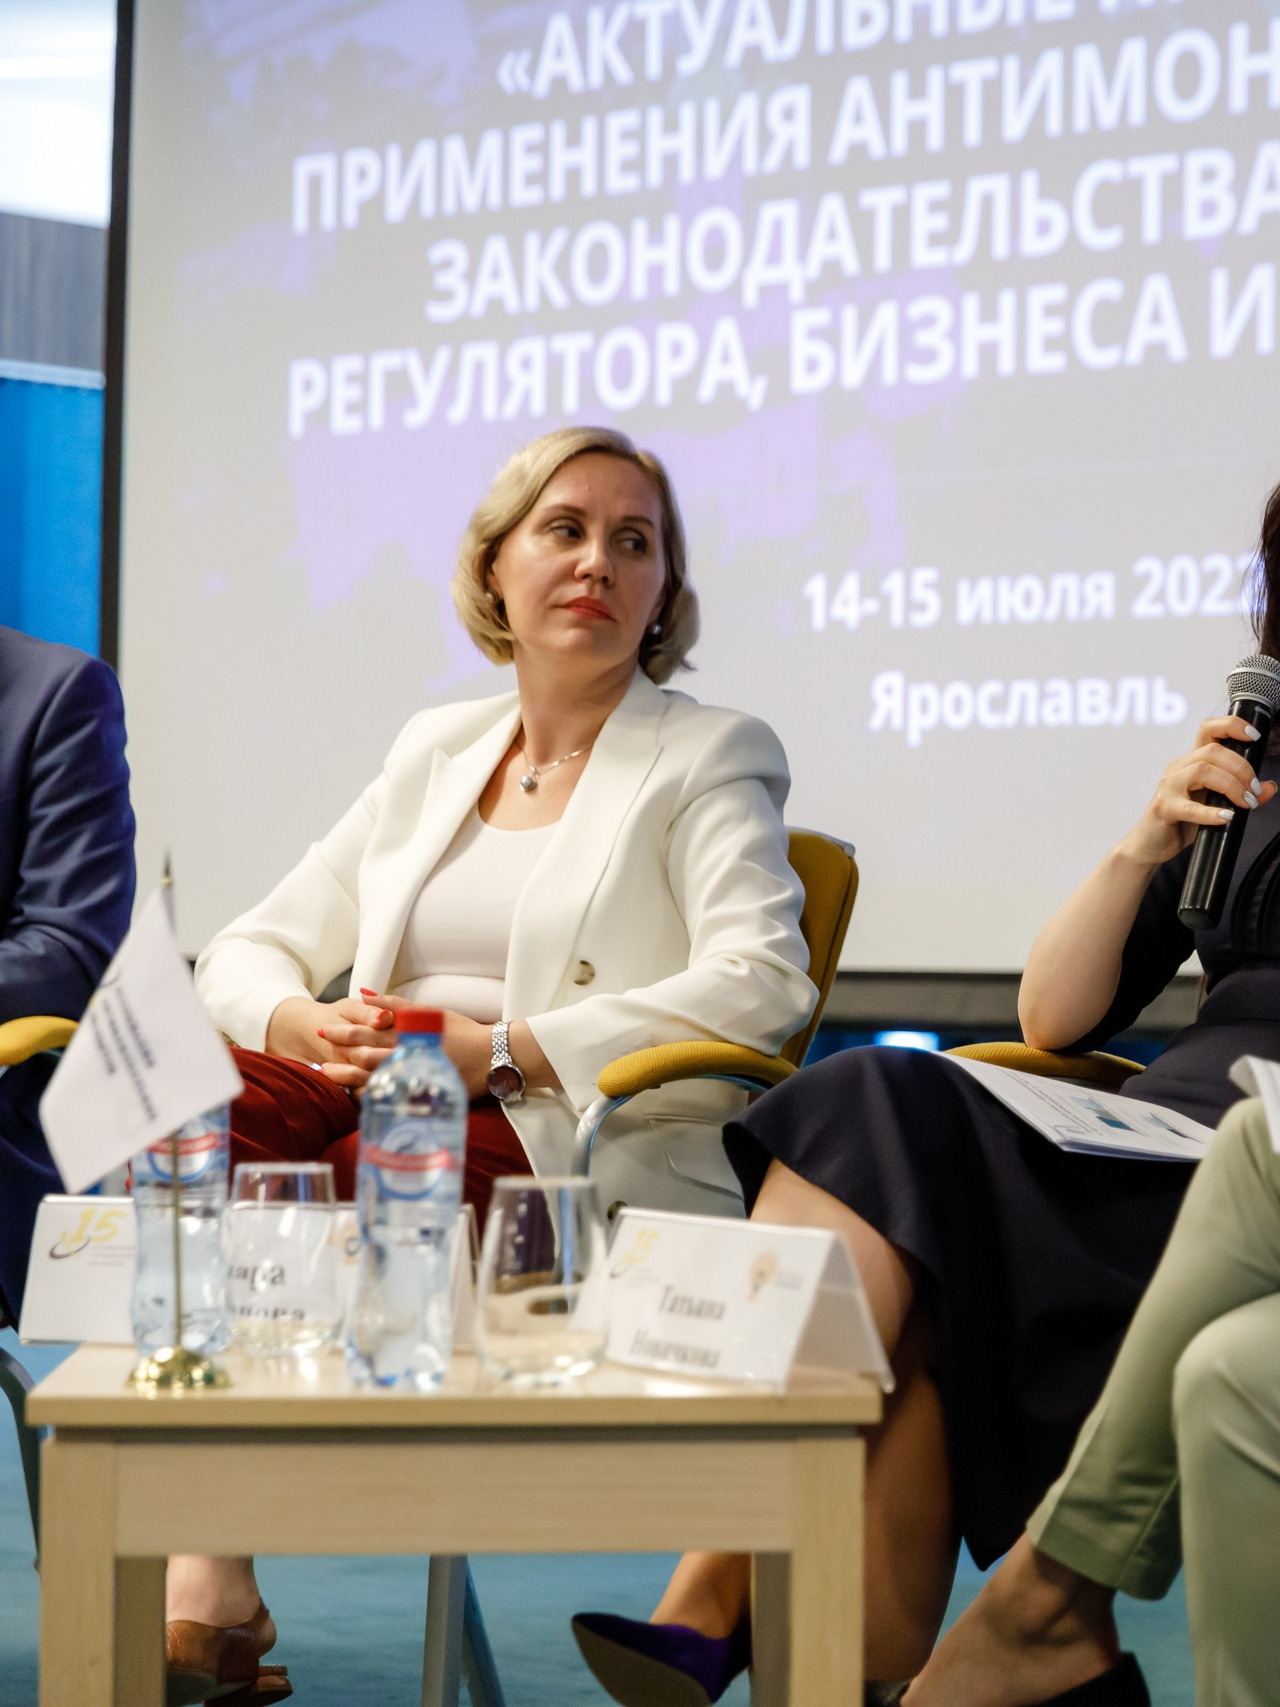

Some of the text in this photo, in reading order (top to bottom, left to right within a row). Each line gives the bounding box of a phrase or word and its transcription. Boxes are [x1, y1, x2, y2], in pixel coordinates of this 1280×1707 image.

[291, 82, 813, 236] ПРИМЕНЕНИЯ
[287, 316, 768, 440] РЕГУЛЯТОРА,
[789, 270, 1190, 397] БИЗНЕСА
[1208, 263, 1277, 360] И
[802, 565, 943, 632] 14-15
[955, 568, 1117, 627] июля
[868, 668, 1187, 747] Ярославль
